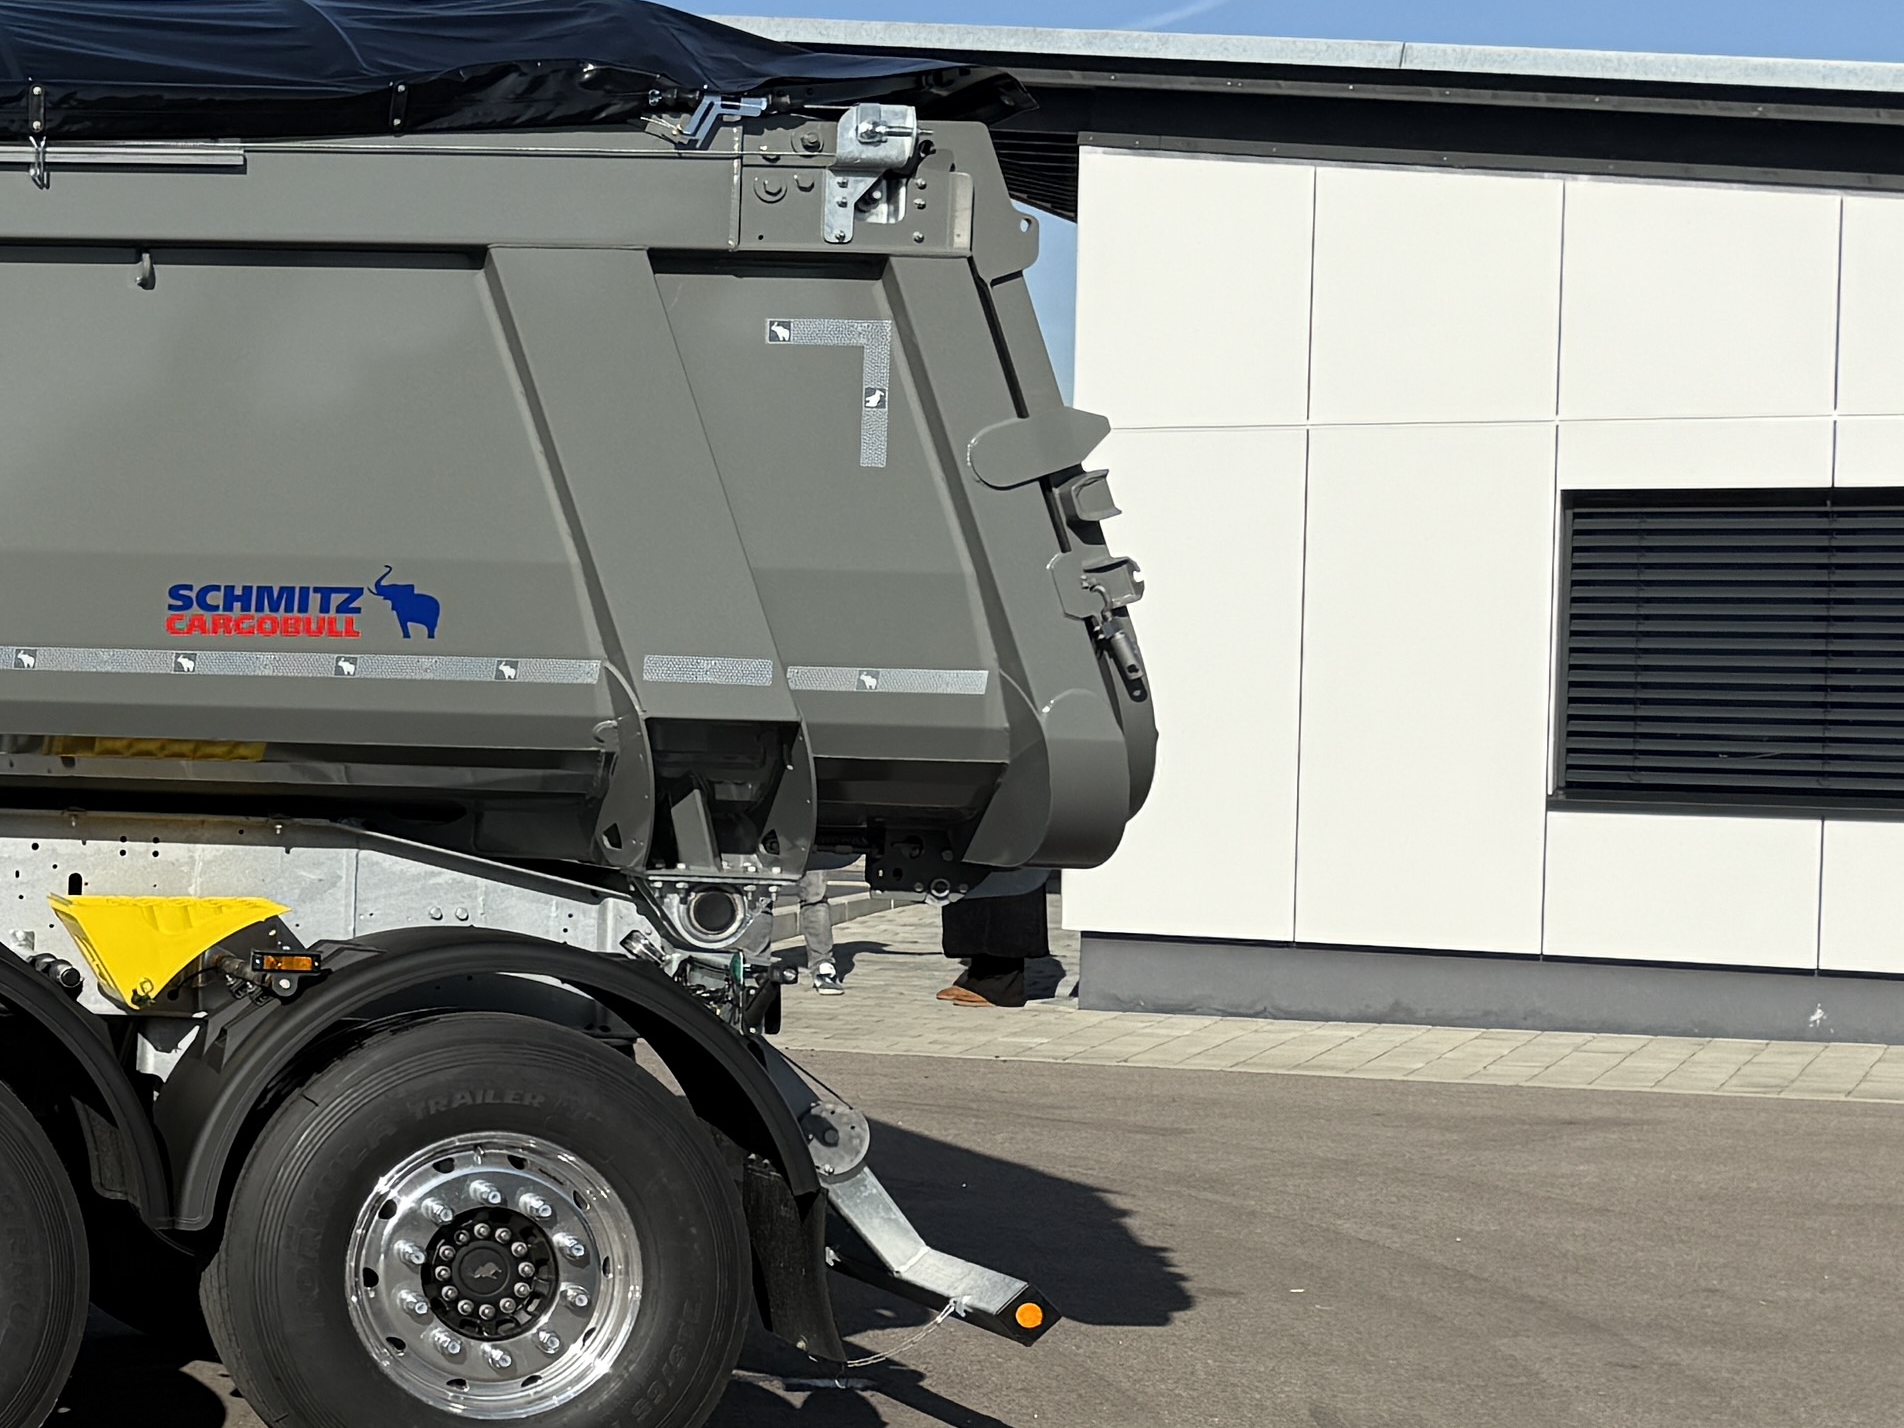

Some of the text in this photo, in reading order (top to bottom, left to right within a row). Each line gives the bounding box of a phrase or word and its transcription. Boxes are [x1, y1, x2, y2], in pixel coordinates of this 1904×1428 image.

[167, 583, 365, 614] SCHMITZ
[165, 613, 362, 639] CARGOBULL
[406, 1088, 548, 1120] TRAILER
